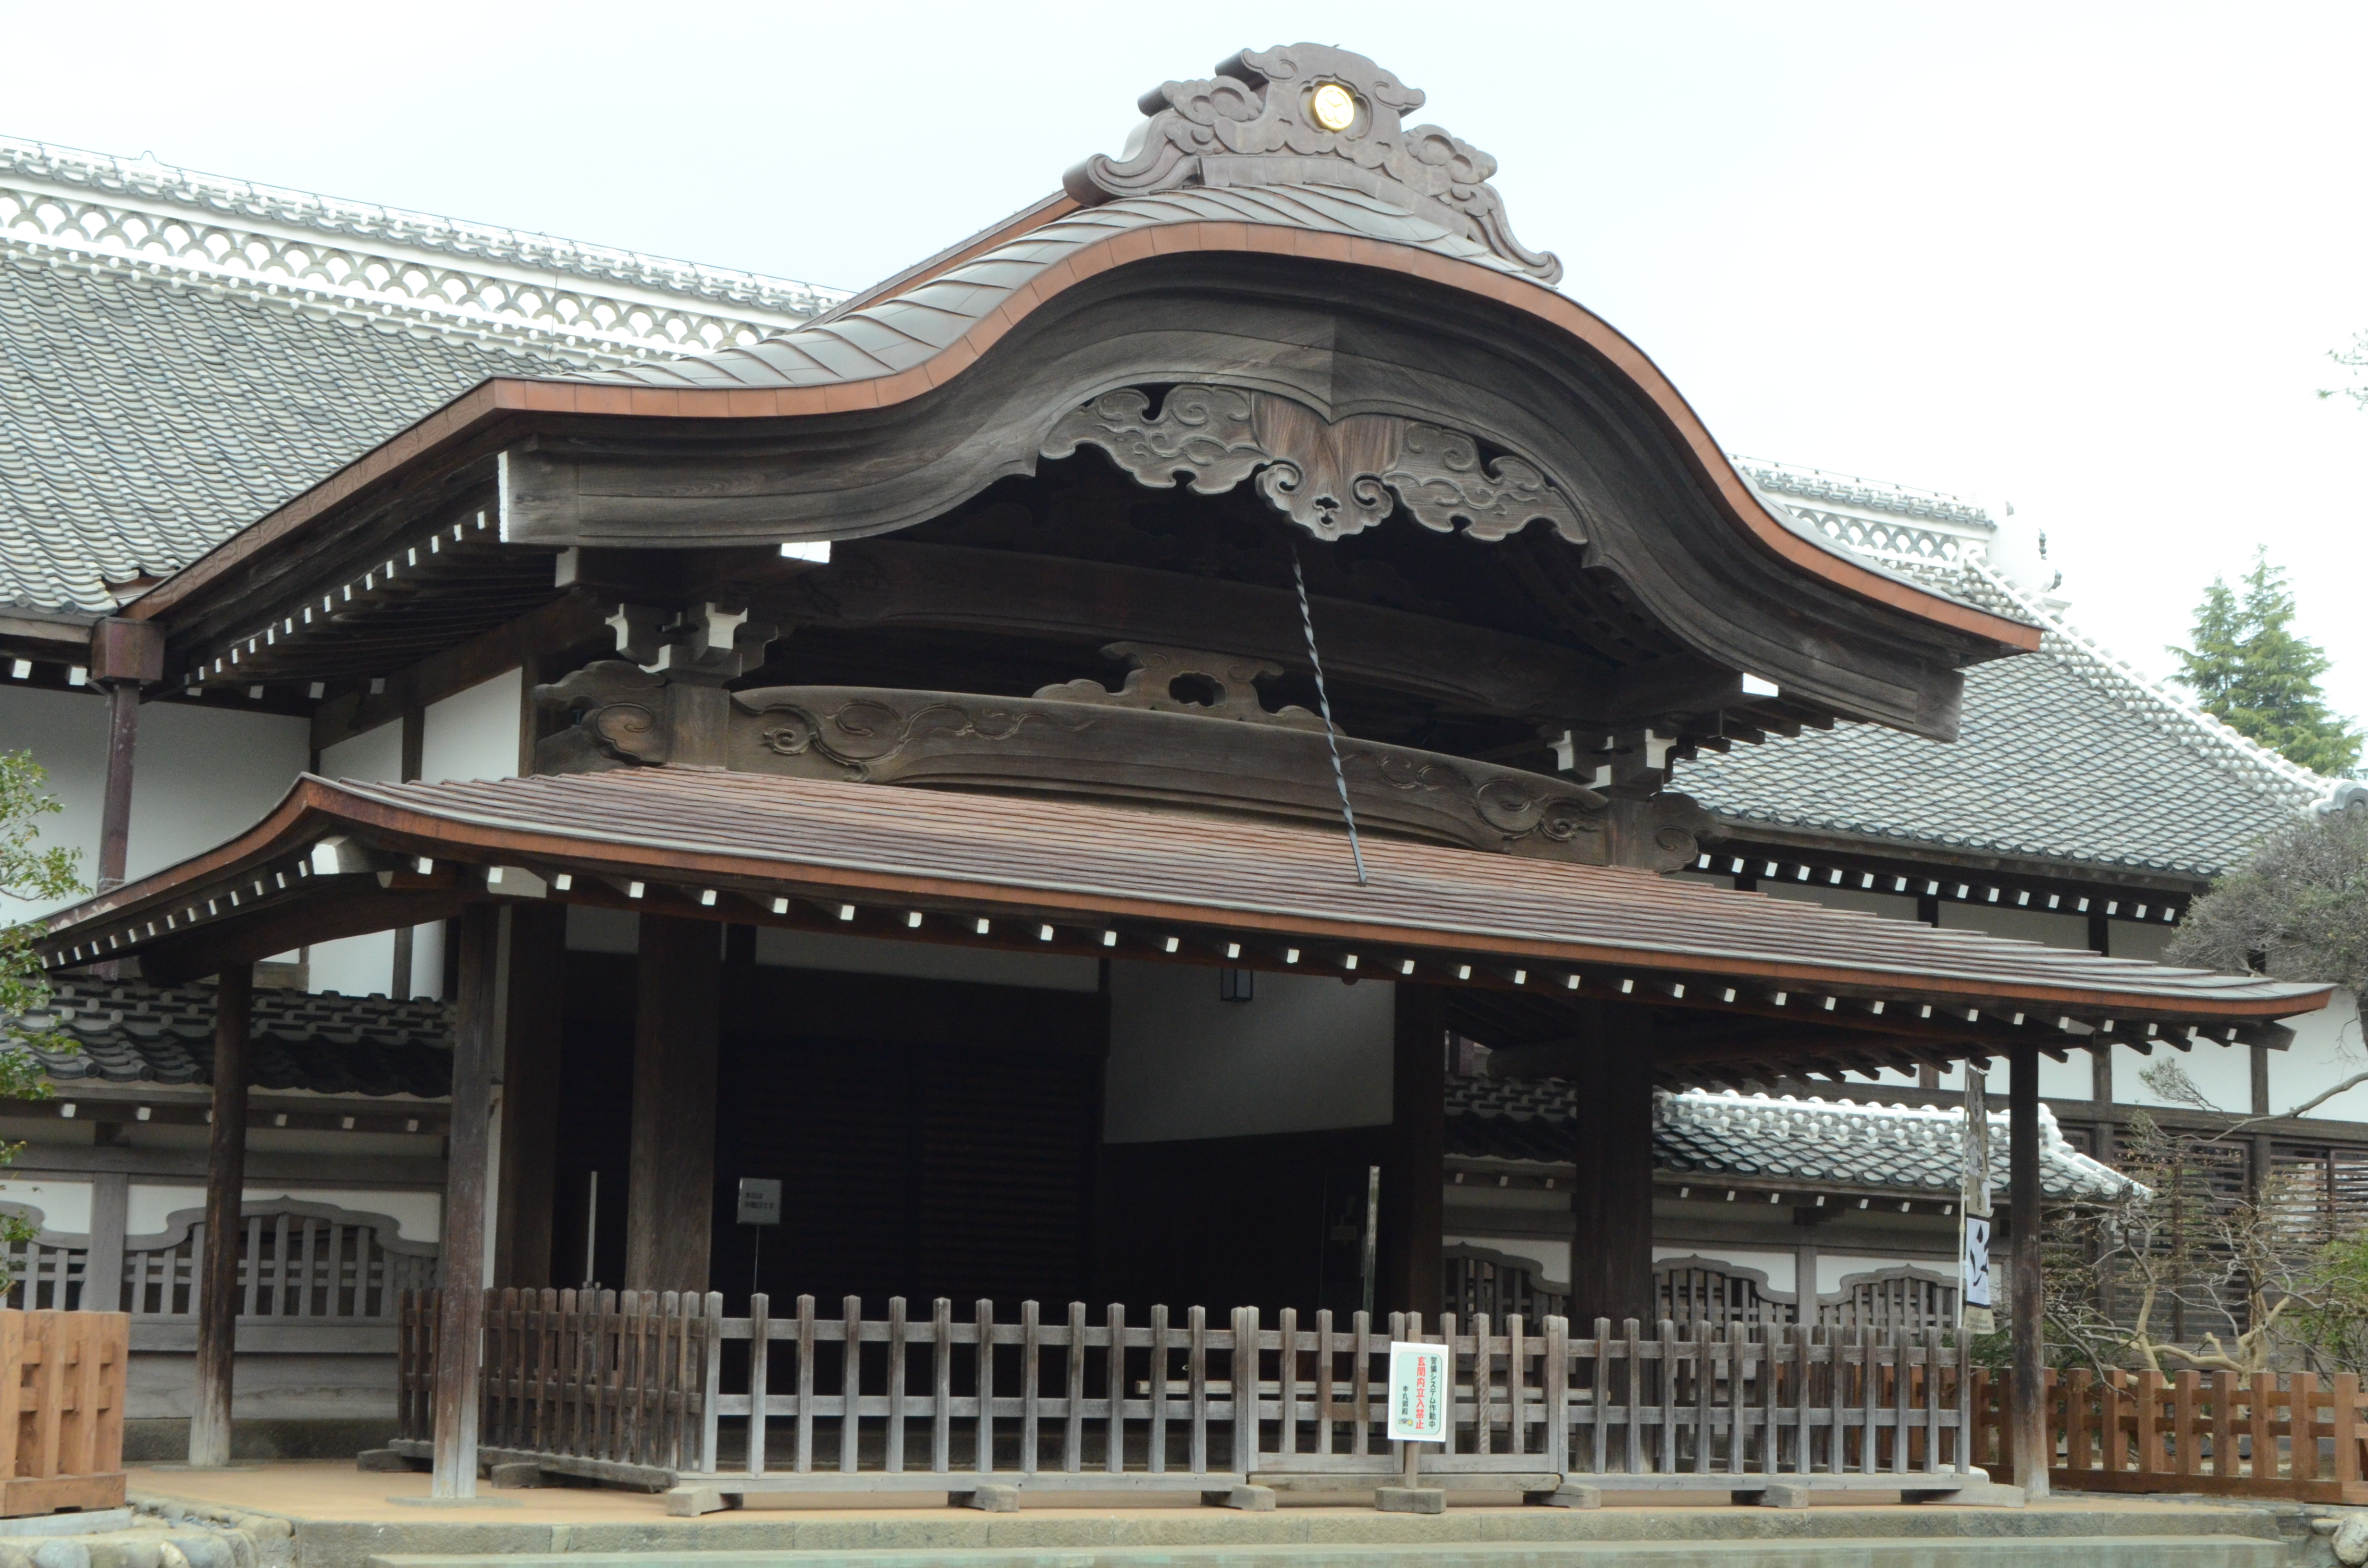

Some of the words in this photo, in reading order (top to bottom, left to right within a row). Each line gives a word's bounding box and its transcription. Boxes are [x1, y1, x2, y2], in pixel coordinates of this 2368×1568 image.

[1416, 1356, 1426, 1430] 玄関内立入禁止
[1429, 1356, 1438, 1429] 警備システム作動中
